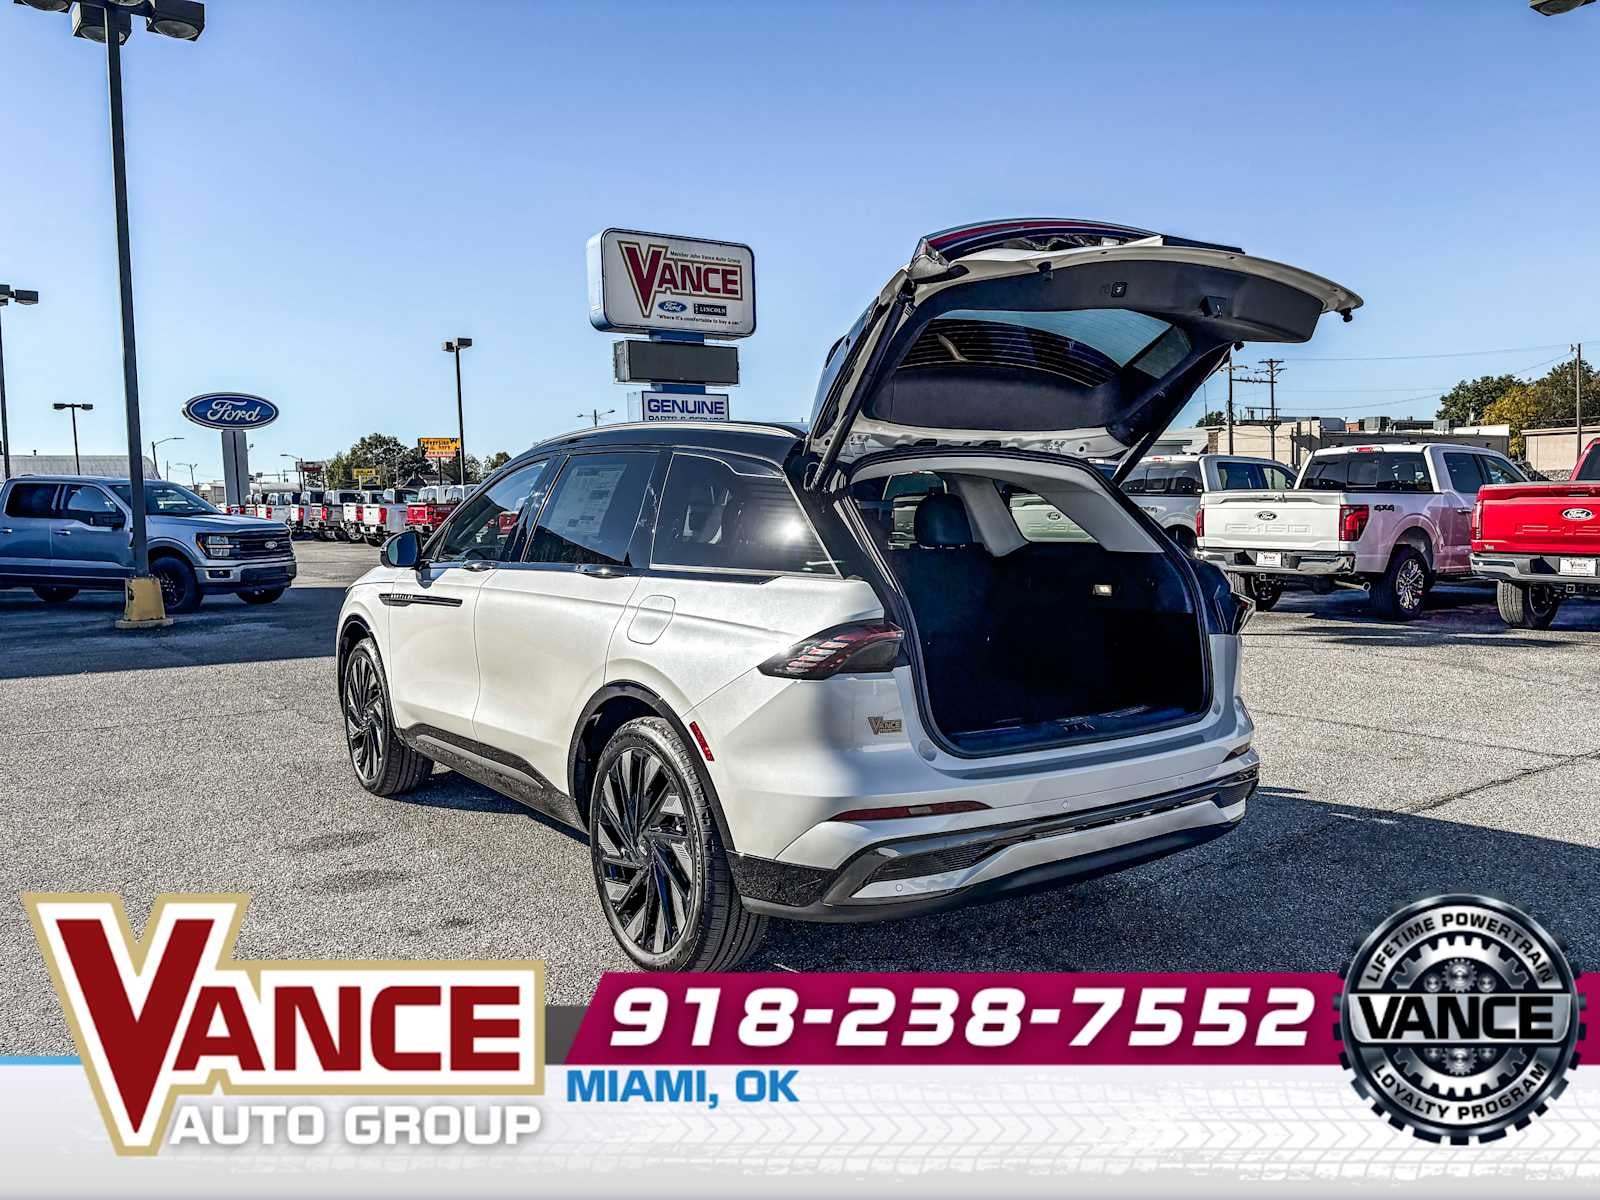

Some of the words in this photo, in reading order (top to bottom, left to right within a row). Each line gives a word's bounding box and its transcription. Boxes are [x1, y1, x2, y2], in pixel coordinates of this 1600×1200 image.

[623, 245, 741, 316] VANCE
[662, 300, 683, 311] Ford
[699, 305, 727, 314] LINCOLN
[207, 399, 261, 421] Ford
[648, 399, 725, 415] GENUINE
[1565, 508, 1588, 518] Ford
[868, 716, 903, 735] VANCE
